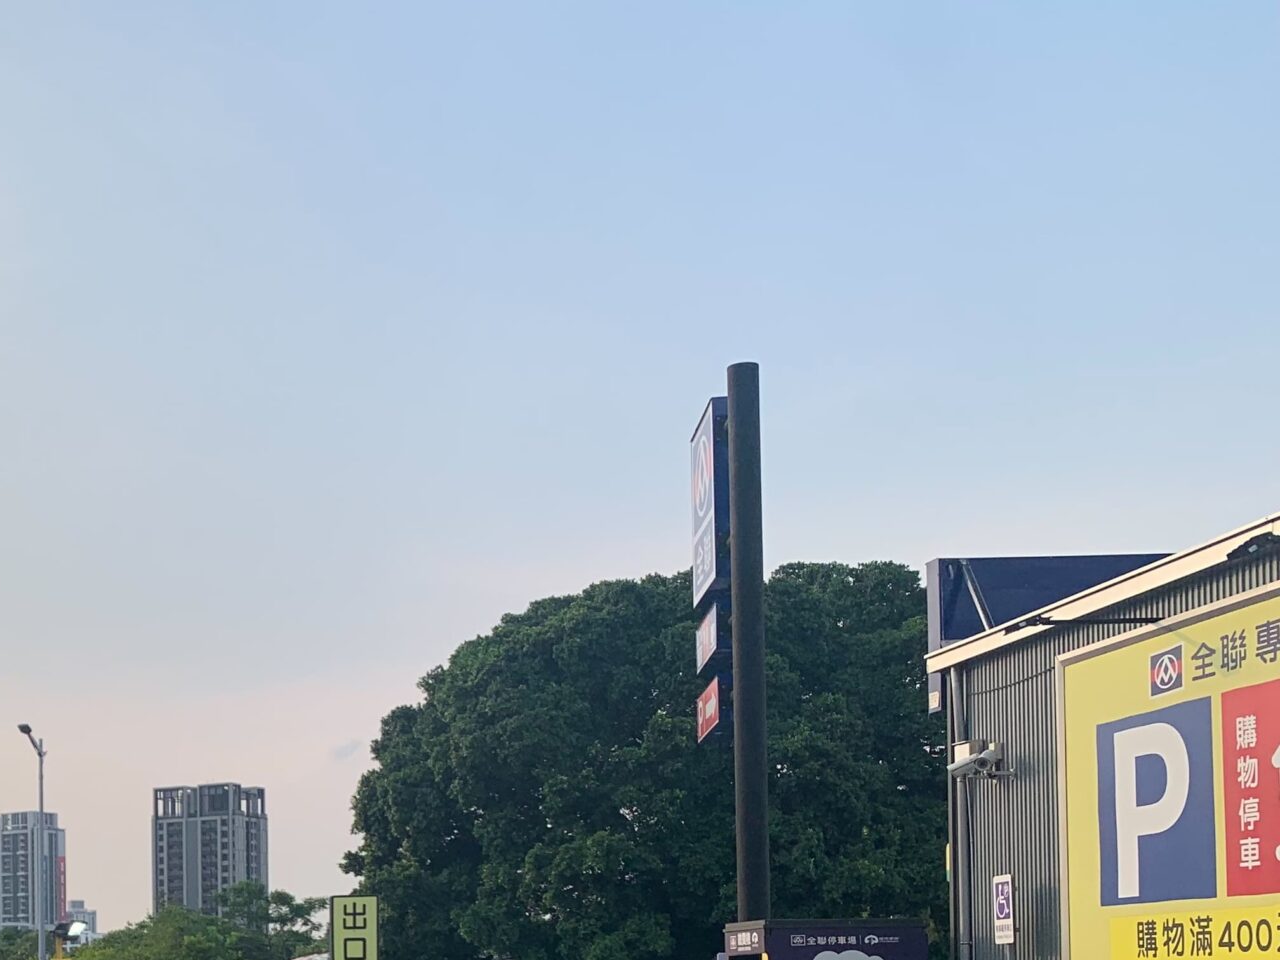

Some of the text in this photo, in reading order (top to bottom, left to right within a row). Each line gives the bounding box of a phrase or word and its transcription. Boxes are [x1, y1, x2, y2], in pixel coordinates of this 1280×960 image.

[1114, 722, 1190, 899] P
[1236, 714, 1262, 870] 購物停車
[343, 902, 367, 960] 出口
[806, 935, 857, 946] 全聯停車場
[1137, 911, 1280, 959] 購物滿400
